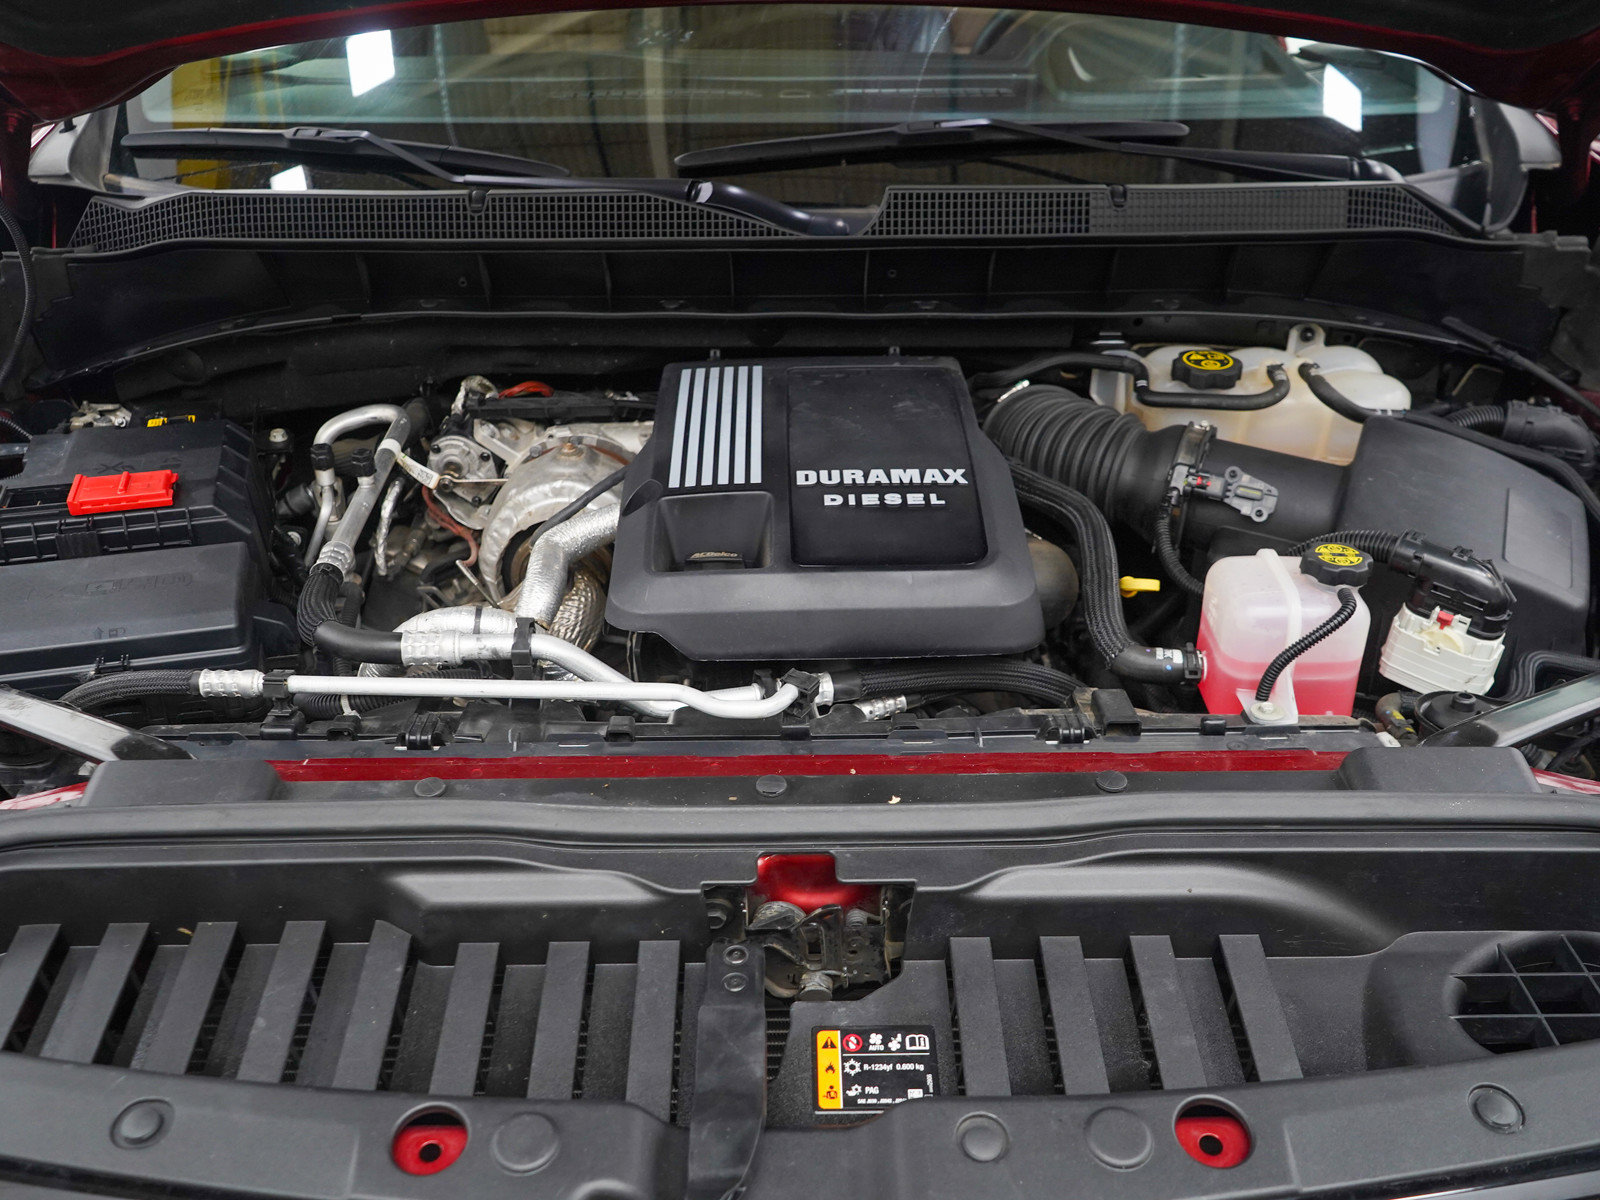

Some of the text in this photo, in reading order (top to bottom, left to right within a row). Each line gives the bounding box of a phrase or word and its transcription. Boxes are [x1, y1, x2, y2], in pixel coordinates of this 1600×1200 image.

[796, 468, 968, 485] DURAMAX
[823, 493, 946, 507] DIESEL
[863, 1063, 893, 1072] R-1234yf
[915, 1063, 925, 1071] kg
[865, 1086, 880, 1095] PAG
